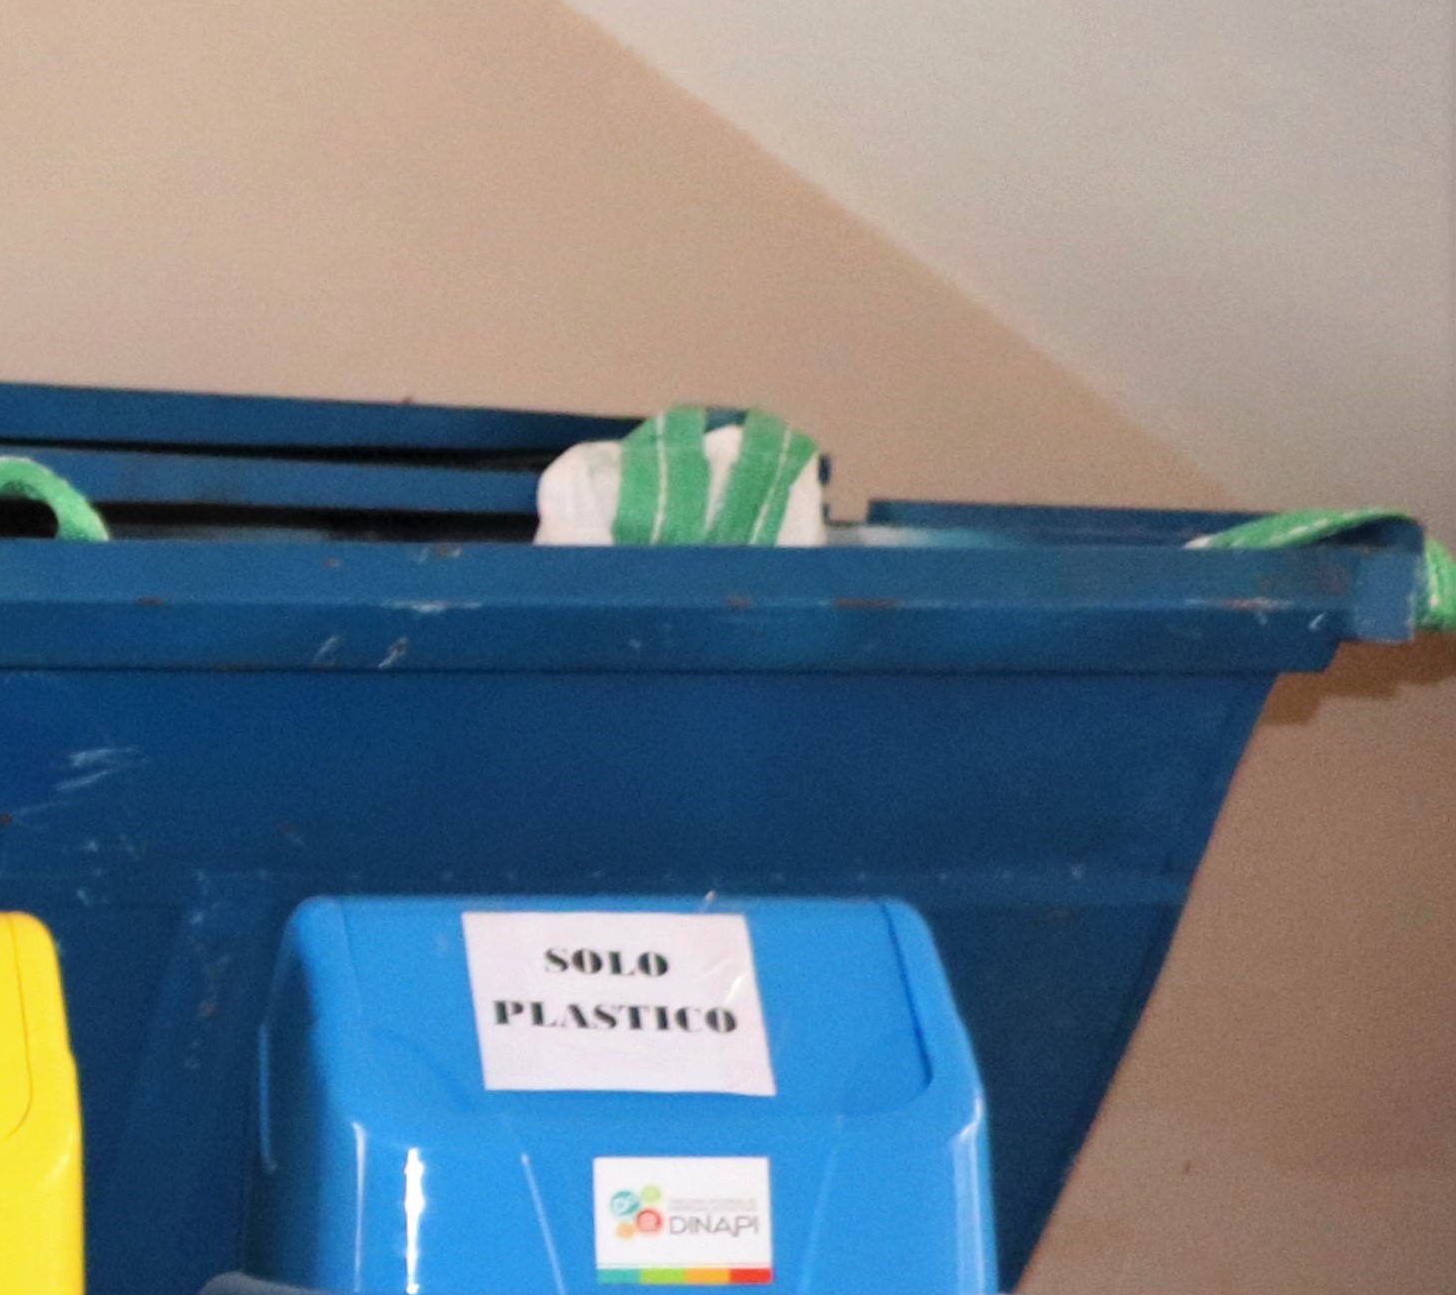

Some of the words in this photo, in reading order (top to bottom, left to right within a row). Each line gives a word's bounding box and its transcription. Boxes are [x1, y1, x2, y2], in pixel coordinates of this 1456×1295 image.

[545, 948, 669, 977] SOLO
[494, 1000, 737, 1034] PLASTICO
[670, 1214, 759, 1237] DINAPI
